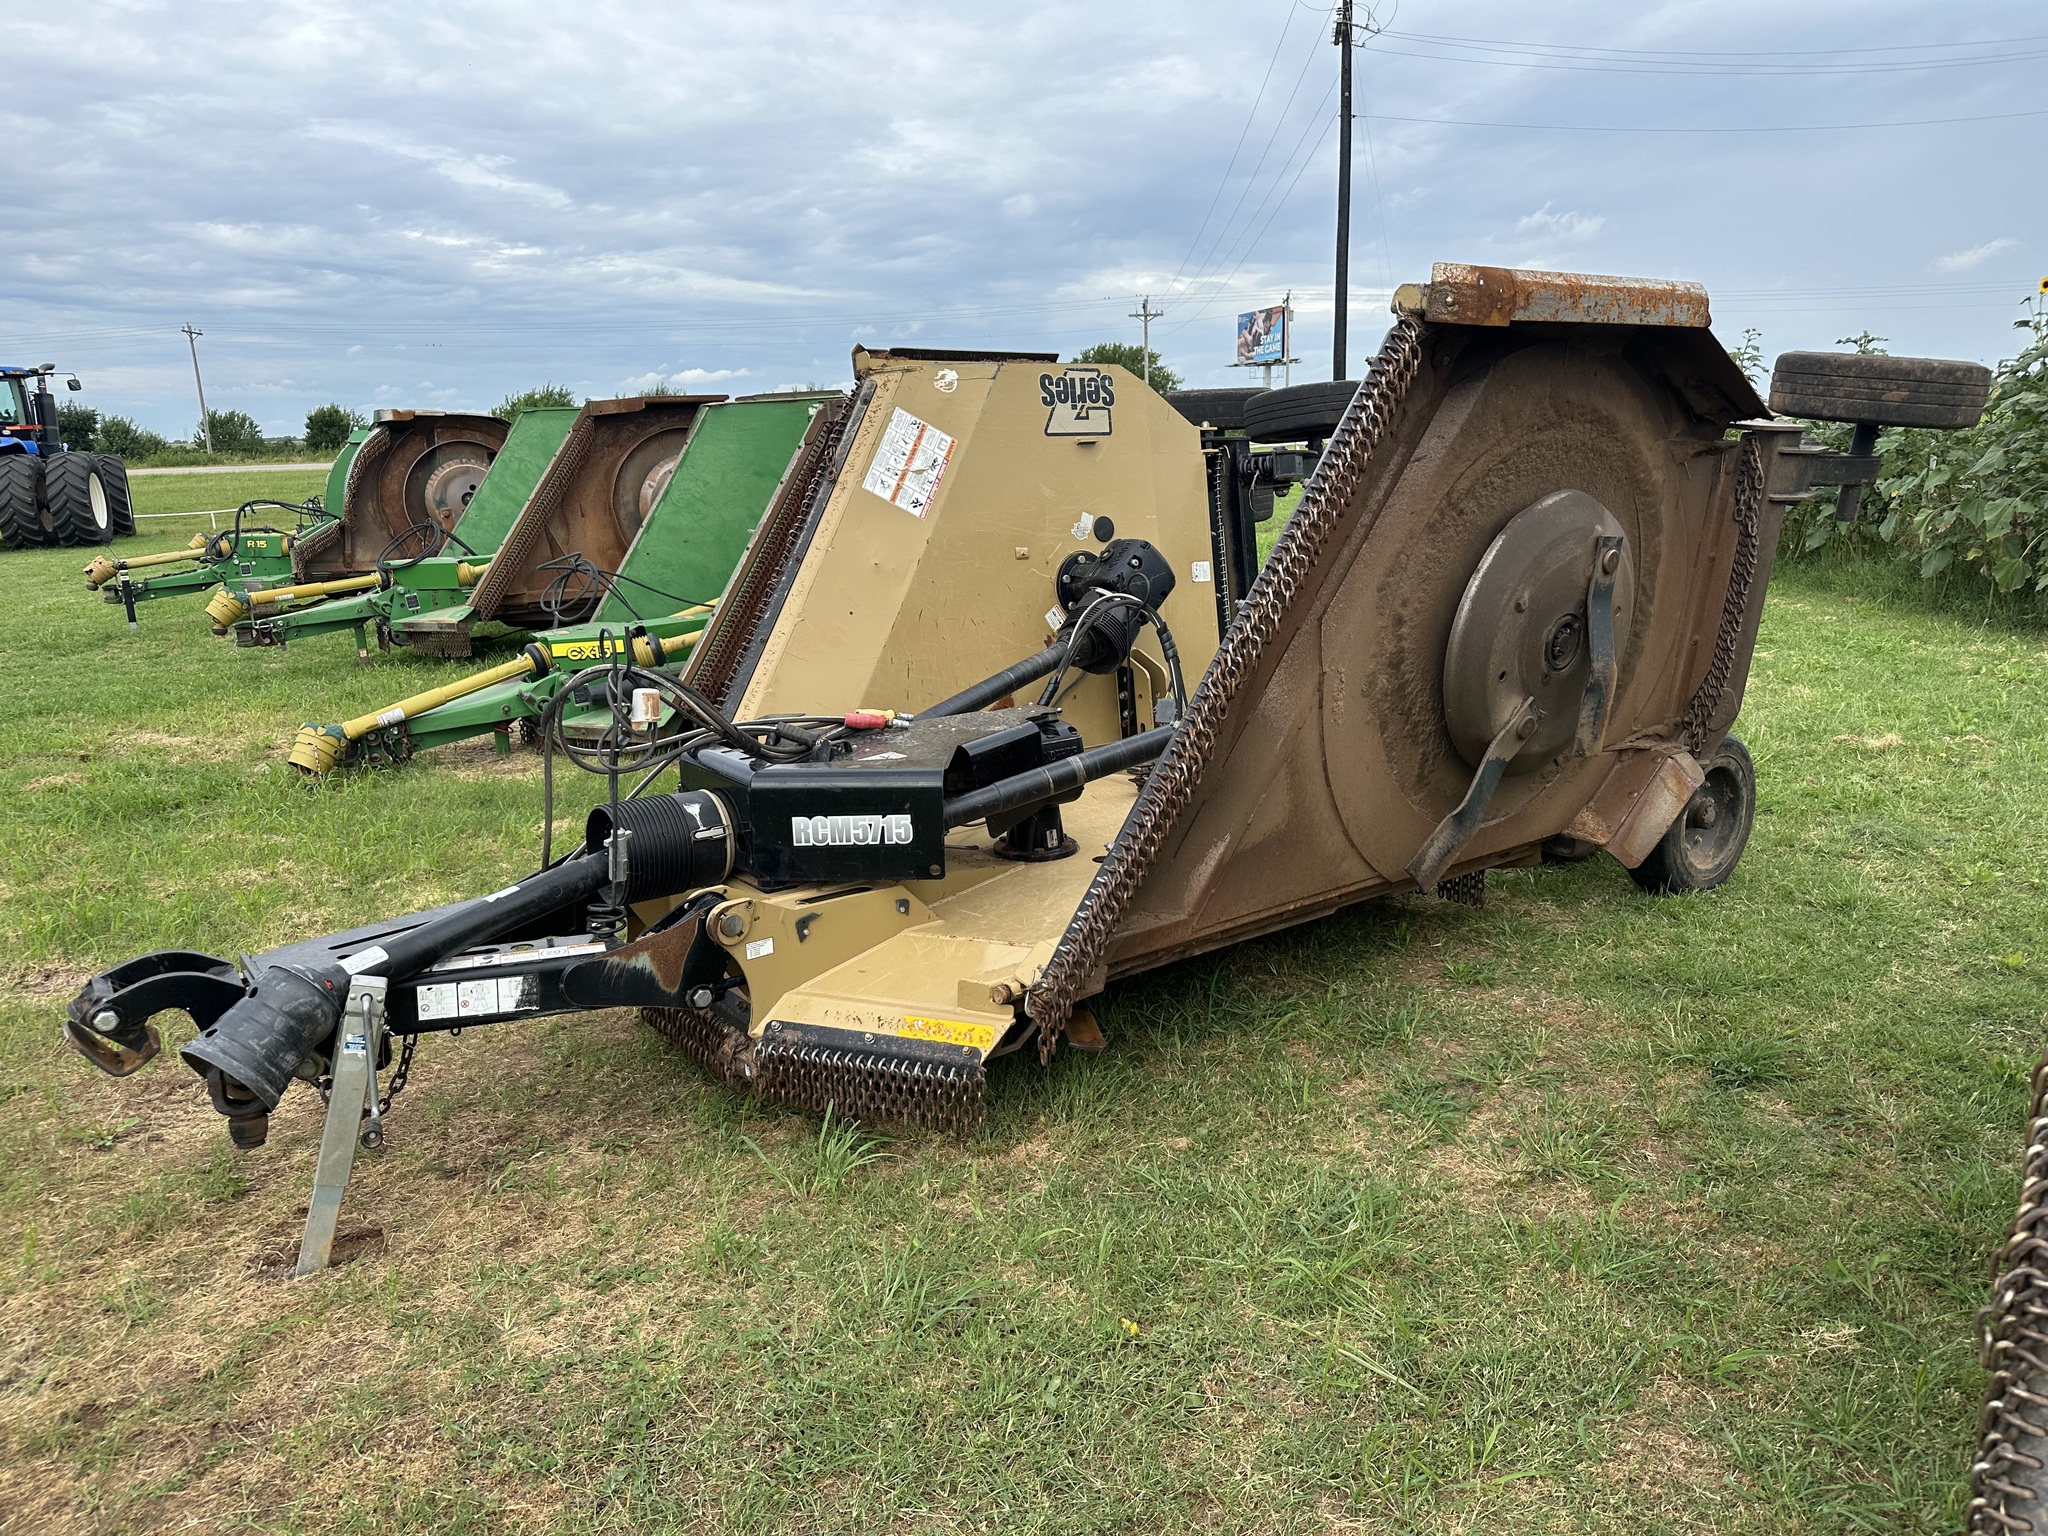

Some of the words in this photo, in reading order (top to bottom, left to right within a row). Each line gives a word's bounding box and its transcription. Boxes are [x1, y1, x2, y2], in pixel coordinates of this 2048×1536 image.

[1260, 333, 1275, 345] STAY
[1275, 332, 1281, 342] IN
[1253, 345, 1264, 355] THE
[1264, 342, 1281, 354] GAME
[1039, 373, 1115, 410] Series
[567, 644, 612, 661] CX15
[792, 815, 913, 846] RCM5715
